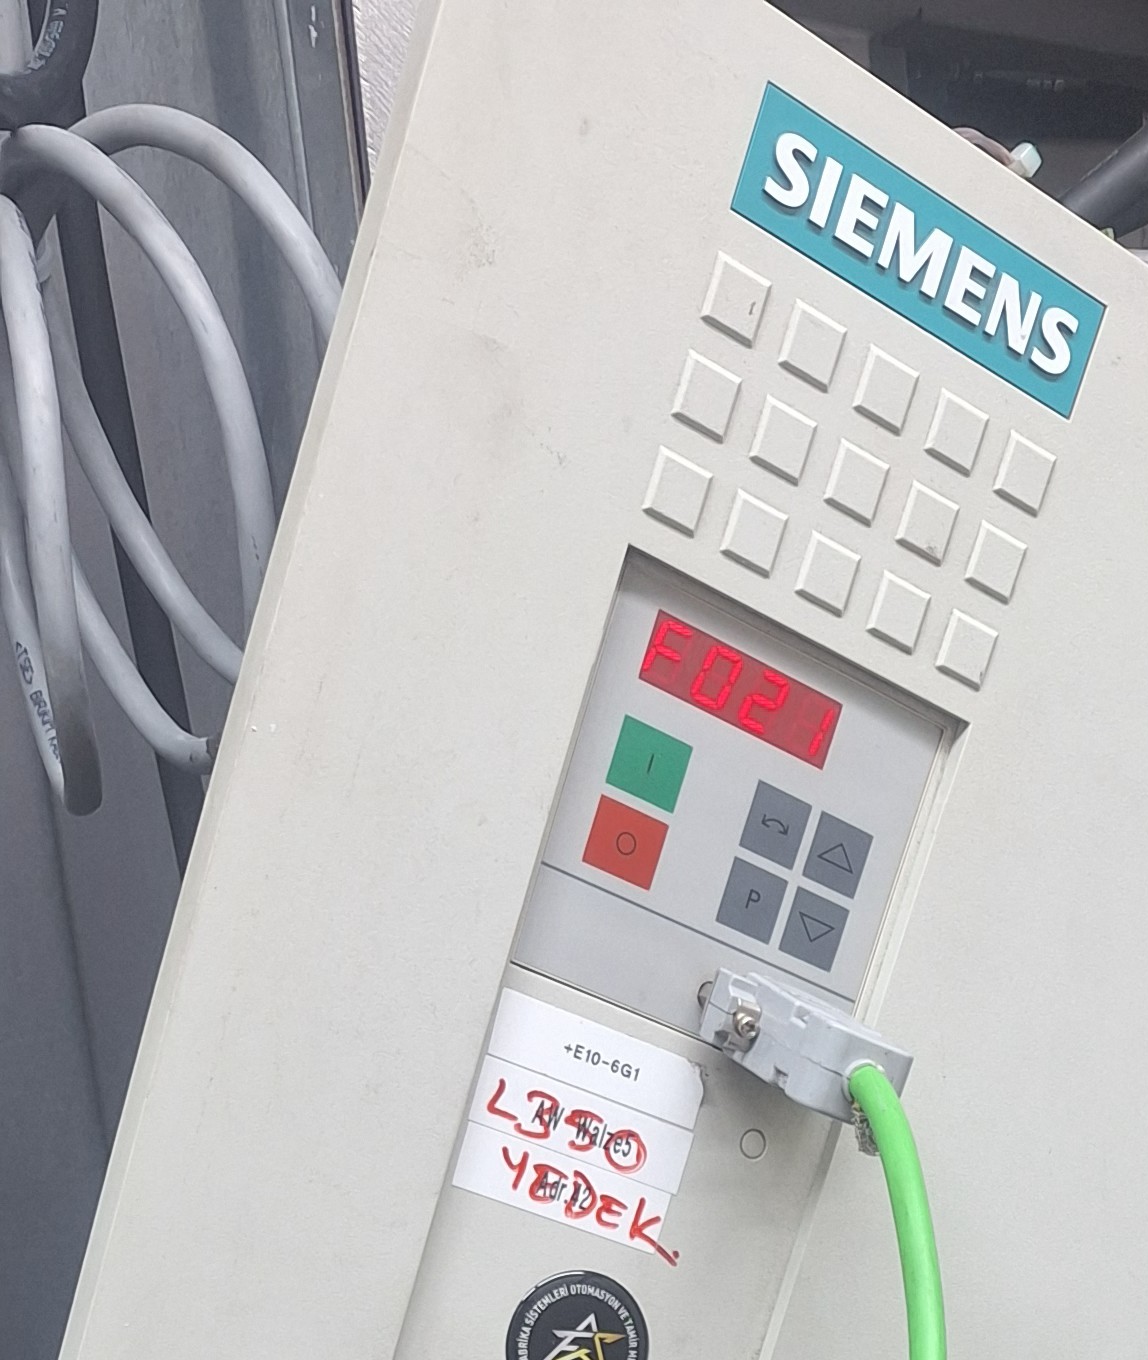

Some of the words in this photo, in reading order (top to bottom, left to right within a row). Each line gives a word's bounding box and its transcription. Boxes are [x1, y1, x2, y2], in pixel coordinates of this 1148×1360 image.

[763, 130, 1080, 378] SIEMENS
[642, 619, 834, 757] F021
[745, 888, 761, 909] P
[563, 1043, 640, 1082] +E10-6G1
[570, 1283, 621, 1310] OTOMASYON
[617, 1305, 628, 1321] VE
